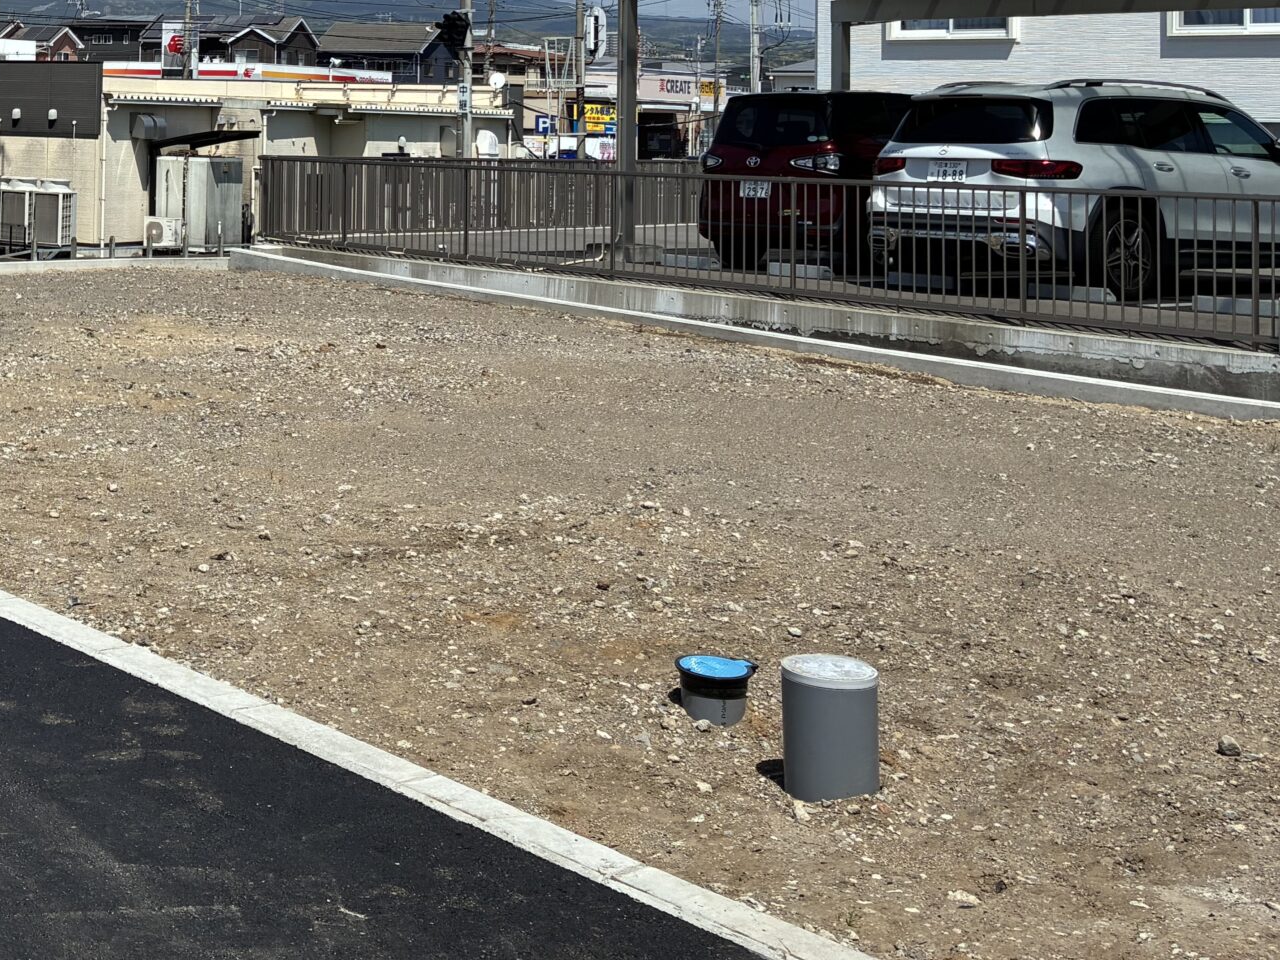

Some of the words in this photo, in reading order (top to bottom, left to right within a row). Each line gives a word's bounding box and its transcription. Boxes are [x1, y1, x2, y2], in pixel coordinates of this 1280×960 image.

[666, 79, 691, 95] CREATE
[538, 117, 550, 132] P
[936, 169, 964, 181] 18-88
